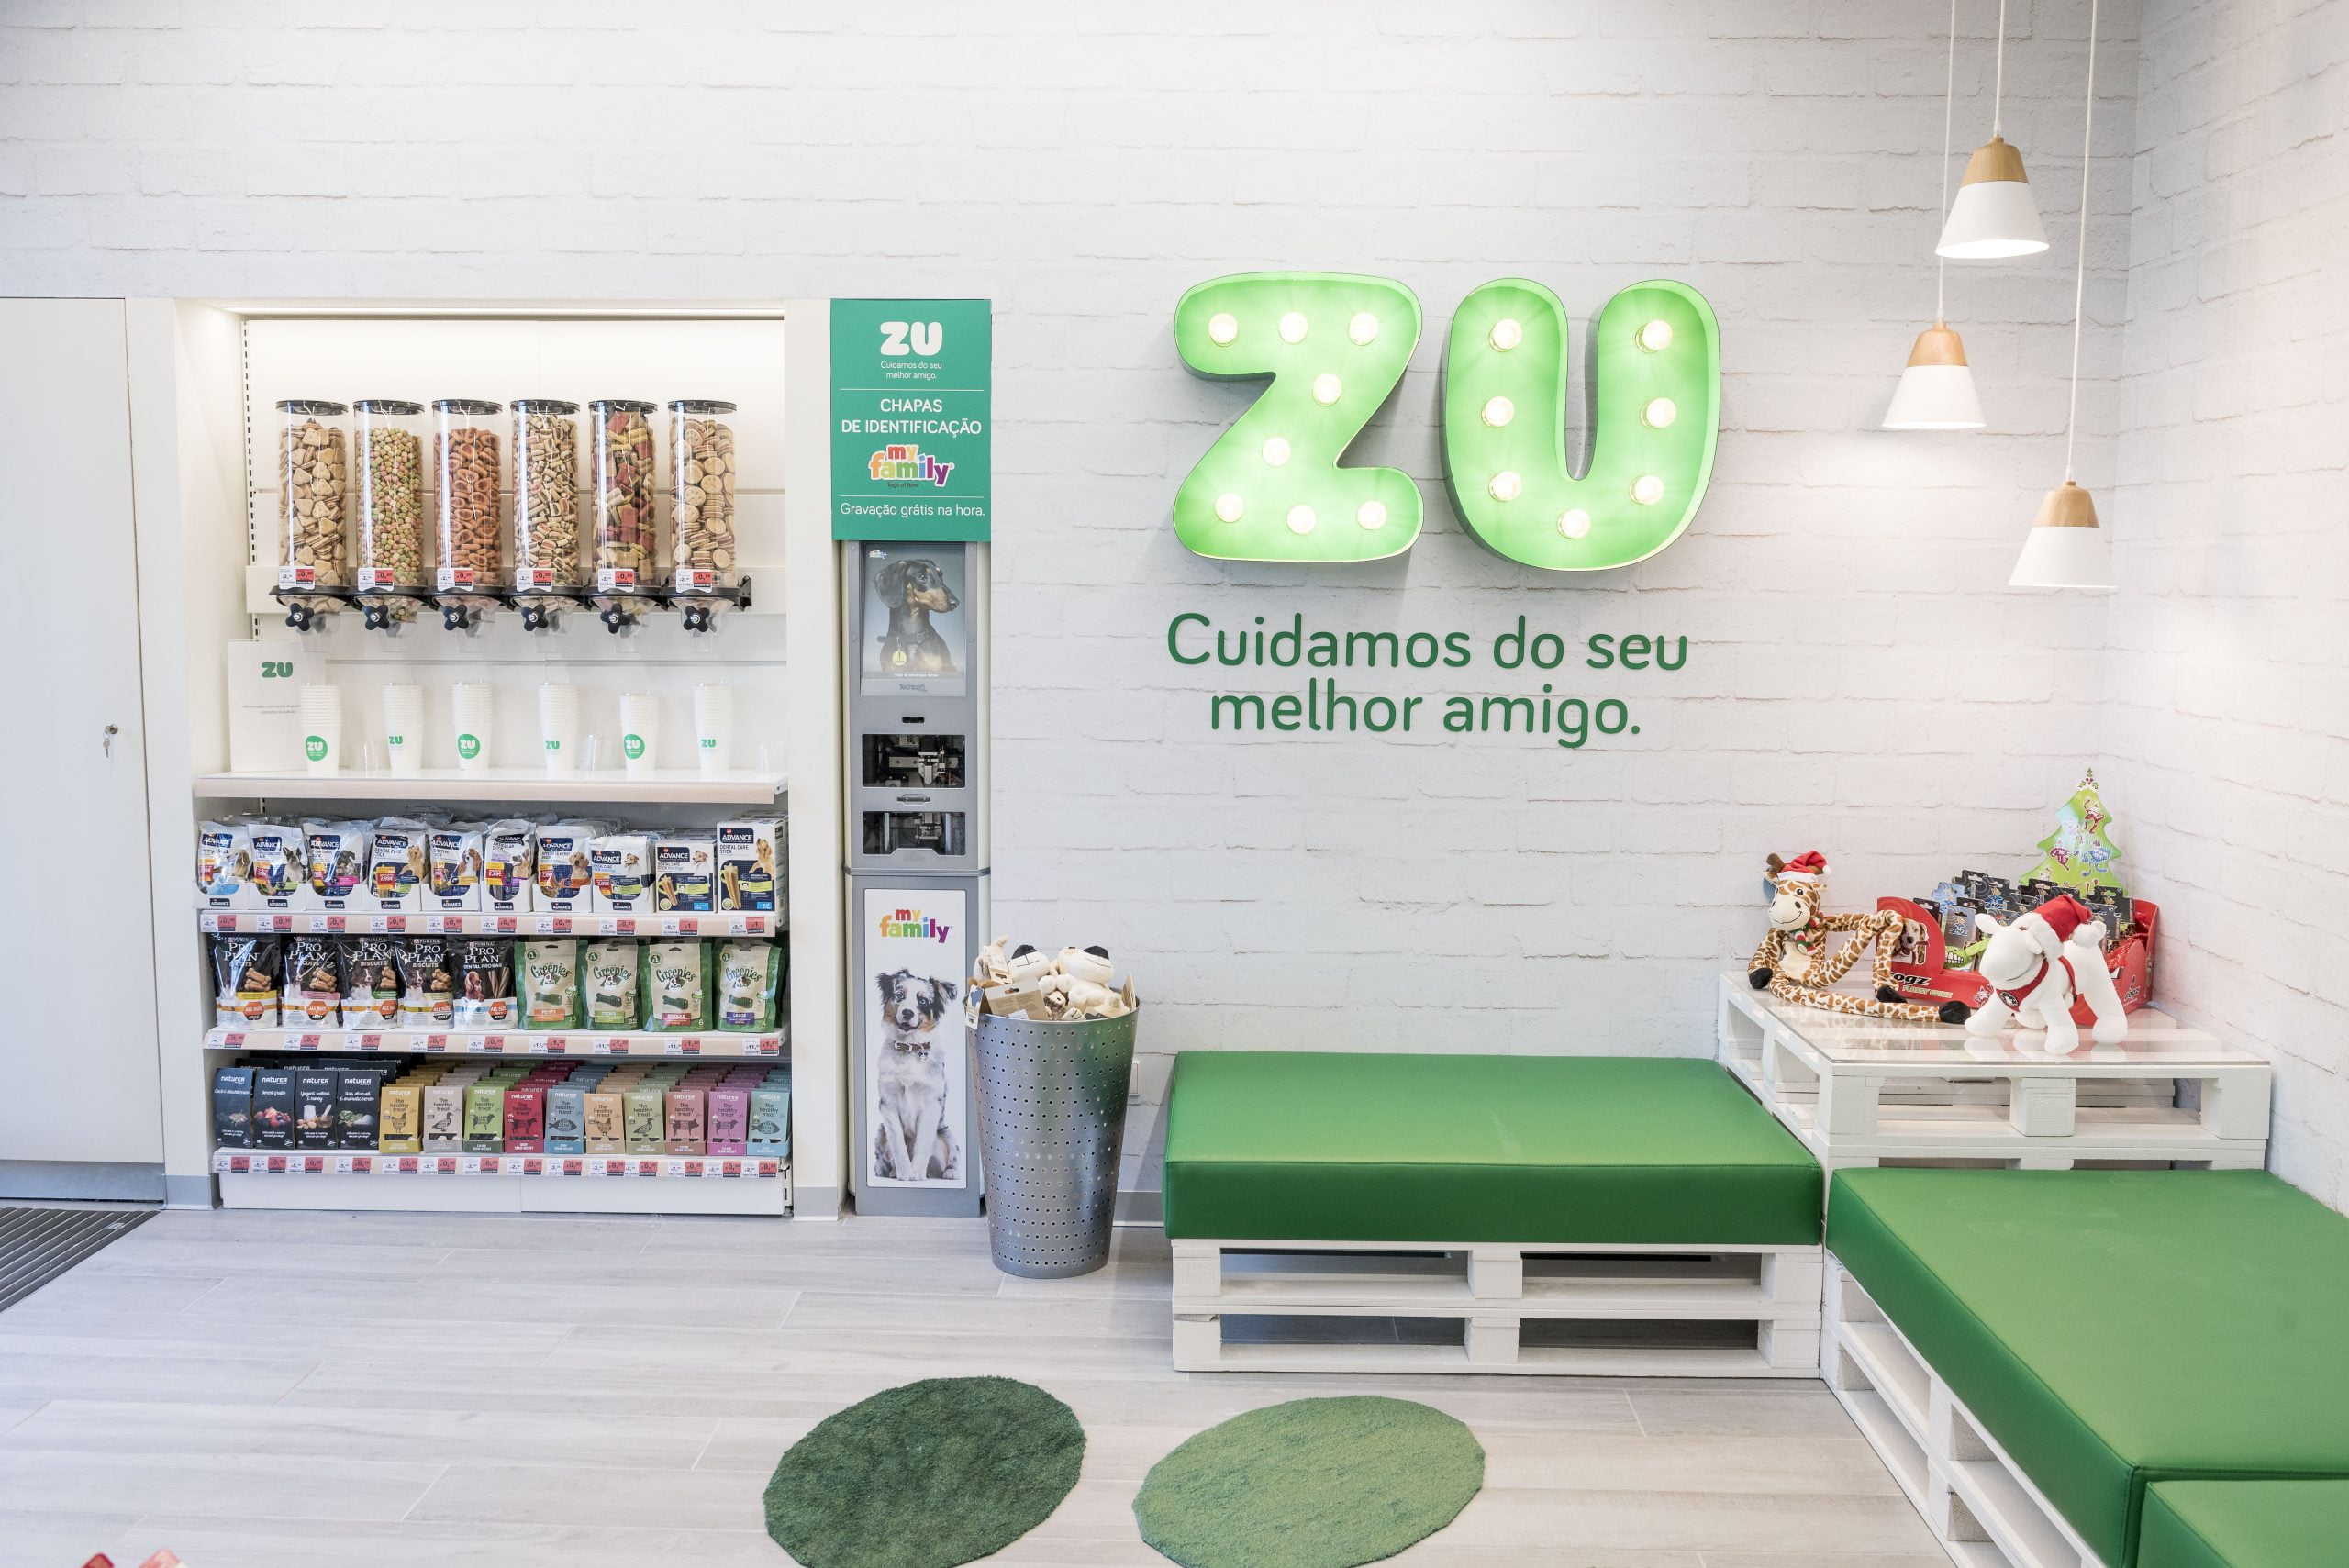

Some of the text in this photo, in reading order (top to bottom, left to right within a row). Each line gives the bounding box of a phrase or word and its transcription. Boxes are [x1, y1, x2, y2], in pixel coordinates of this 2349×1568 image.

[880, 321, 943, 356] ZU
[880, 361, 917, 369] Cuidamos
[918, 361, 928, 369] do
[885, 371, 937, 381] melhor amigo.
[880, 398, 943, 413] CHAPAS
[841, 417, 982, 438] DE IDENTIFICAÇÃO
[1173, 271, 1721, 572] ZU
[887, 445, 918, 460] my
[870, 452, 949, 486] family
[841, 502, 985, 517] Gravação grátis na hora.
[1167, 612, 1688, 671] Cuidamos do seu
[262, 662, 294, 678] ZU
[1210, 677, 1641, 749] melhor amigo.
[307, 741, 323, 751] ZU
[389, 735, 403, 744] ZU
[461, 740, 476, 749] ZU
[546, 740, 560, 750] ZU
[626, 740, 640, 749] ZU
[701, 739, 717, 748] ZU
[896, 908, 920, 922] my
[879, 915, 950, 943] family
[296, 941, 321, 951] PRO
[361, 942, 387, 952] PRO
[415, 943, 440, 953] PRO
[470, 947, 495, 955] PRO
[288, 950, 328, 961] PLAN
[354, 951, 391, 961] PLAN
[407, 952, 444, 962] PLAN
[463, 954, 500, 963] PLAN
[530, 962, 571, 979] Greenies
[593, 964, 632, 981] Greenies
[655, 966, 696, 983] Greenies
[725, 966, 763, 983] Greenies
[1891, 972, 1932, 985] ogz
